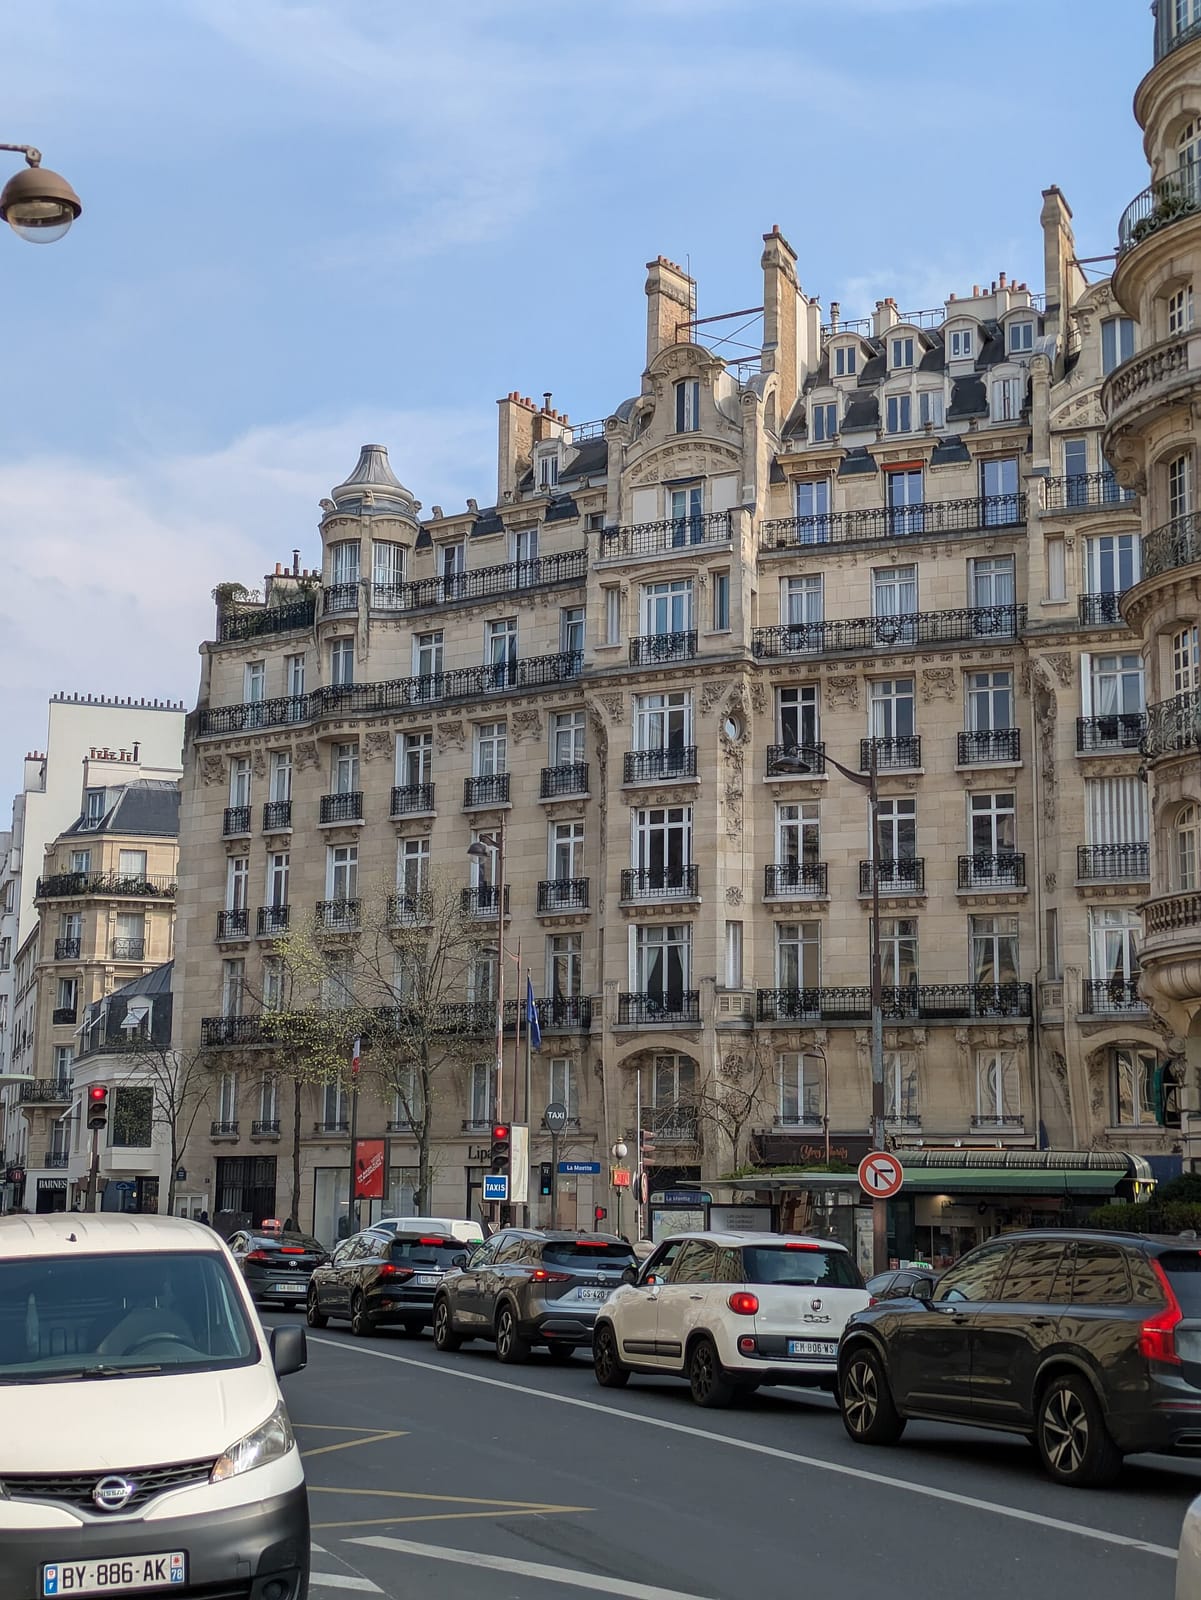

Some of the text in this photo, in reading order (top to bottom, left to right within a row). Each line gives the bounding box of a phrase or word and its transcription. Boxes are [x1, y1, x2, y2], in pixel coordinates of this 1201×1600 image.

[547, 1111, 565, 1120] TAXI
[40, 1179, 68, 1189] BARNES
[486, 1183, 506, 1192] TAXIS
[93, 1488, 132, 1499] NISSAN
[62, 1559, 166, 1588] BY-886-AK
[171, 1569, 183, 1580] 78
